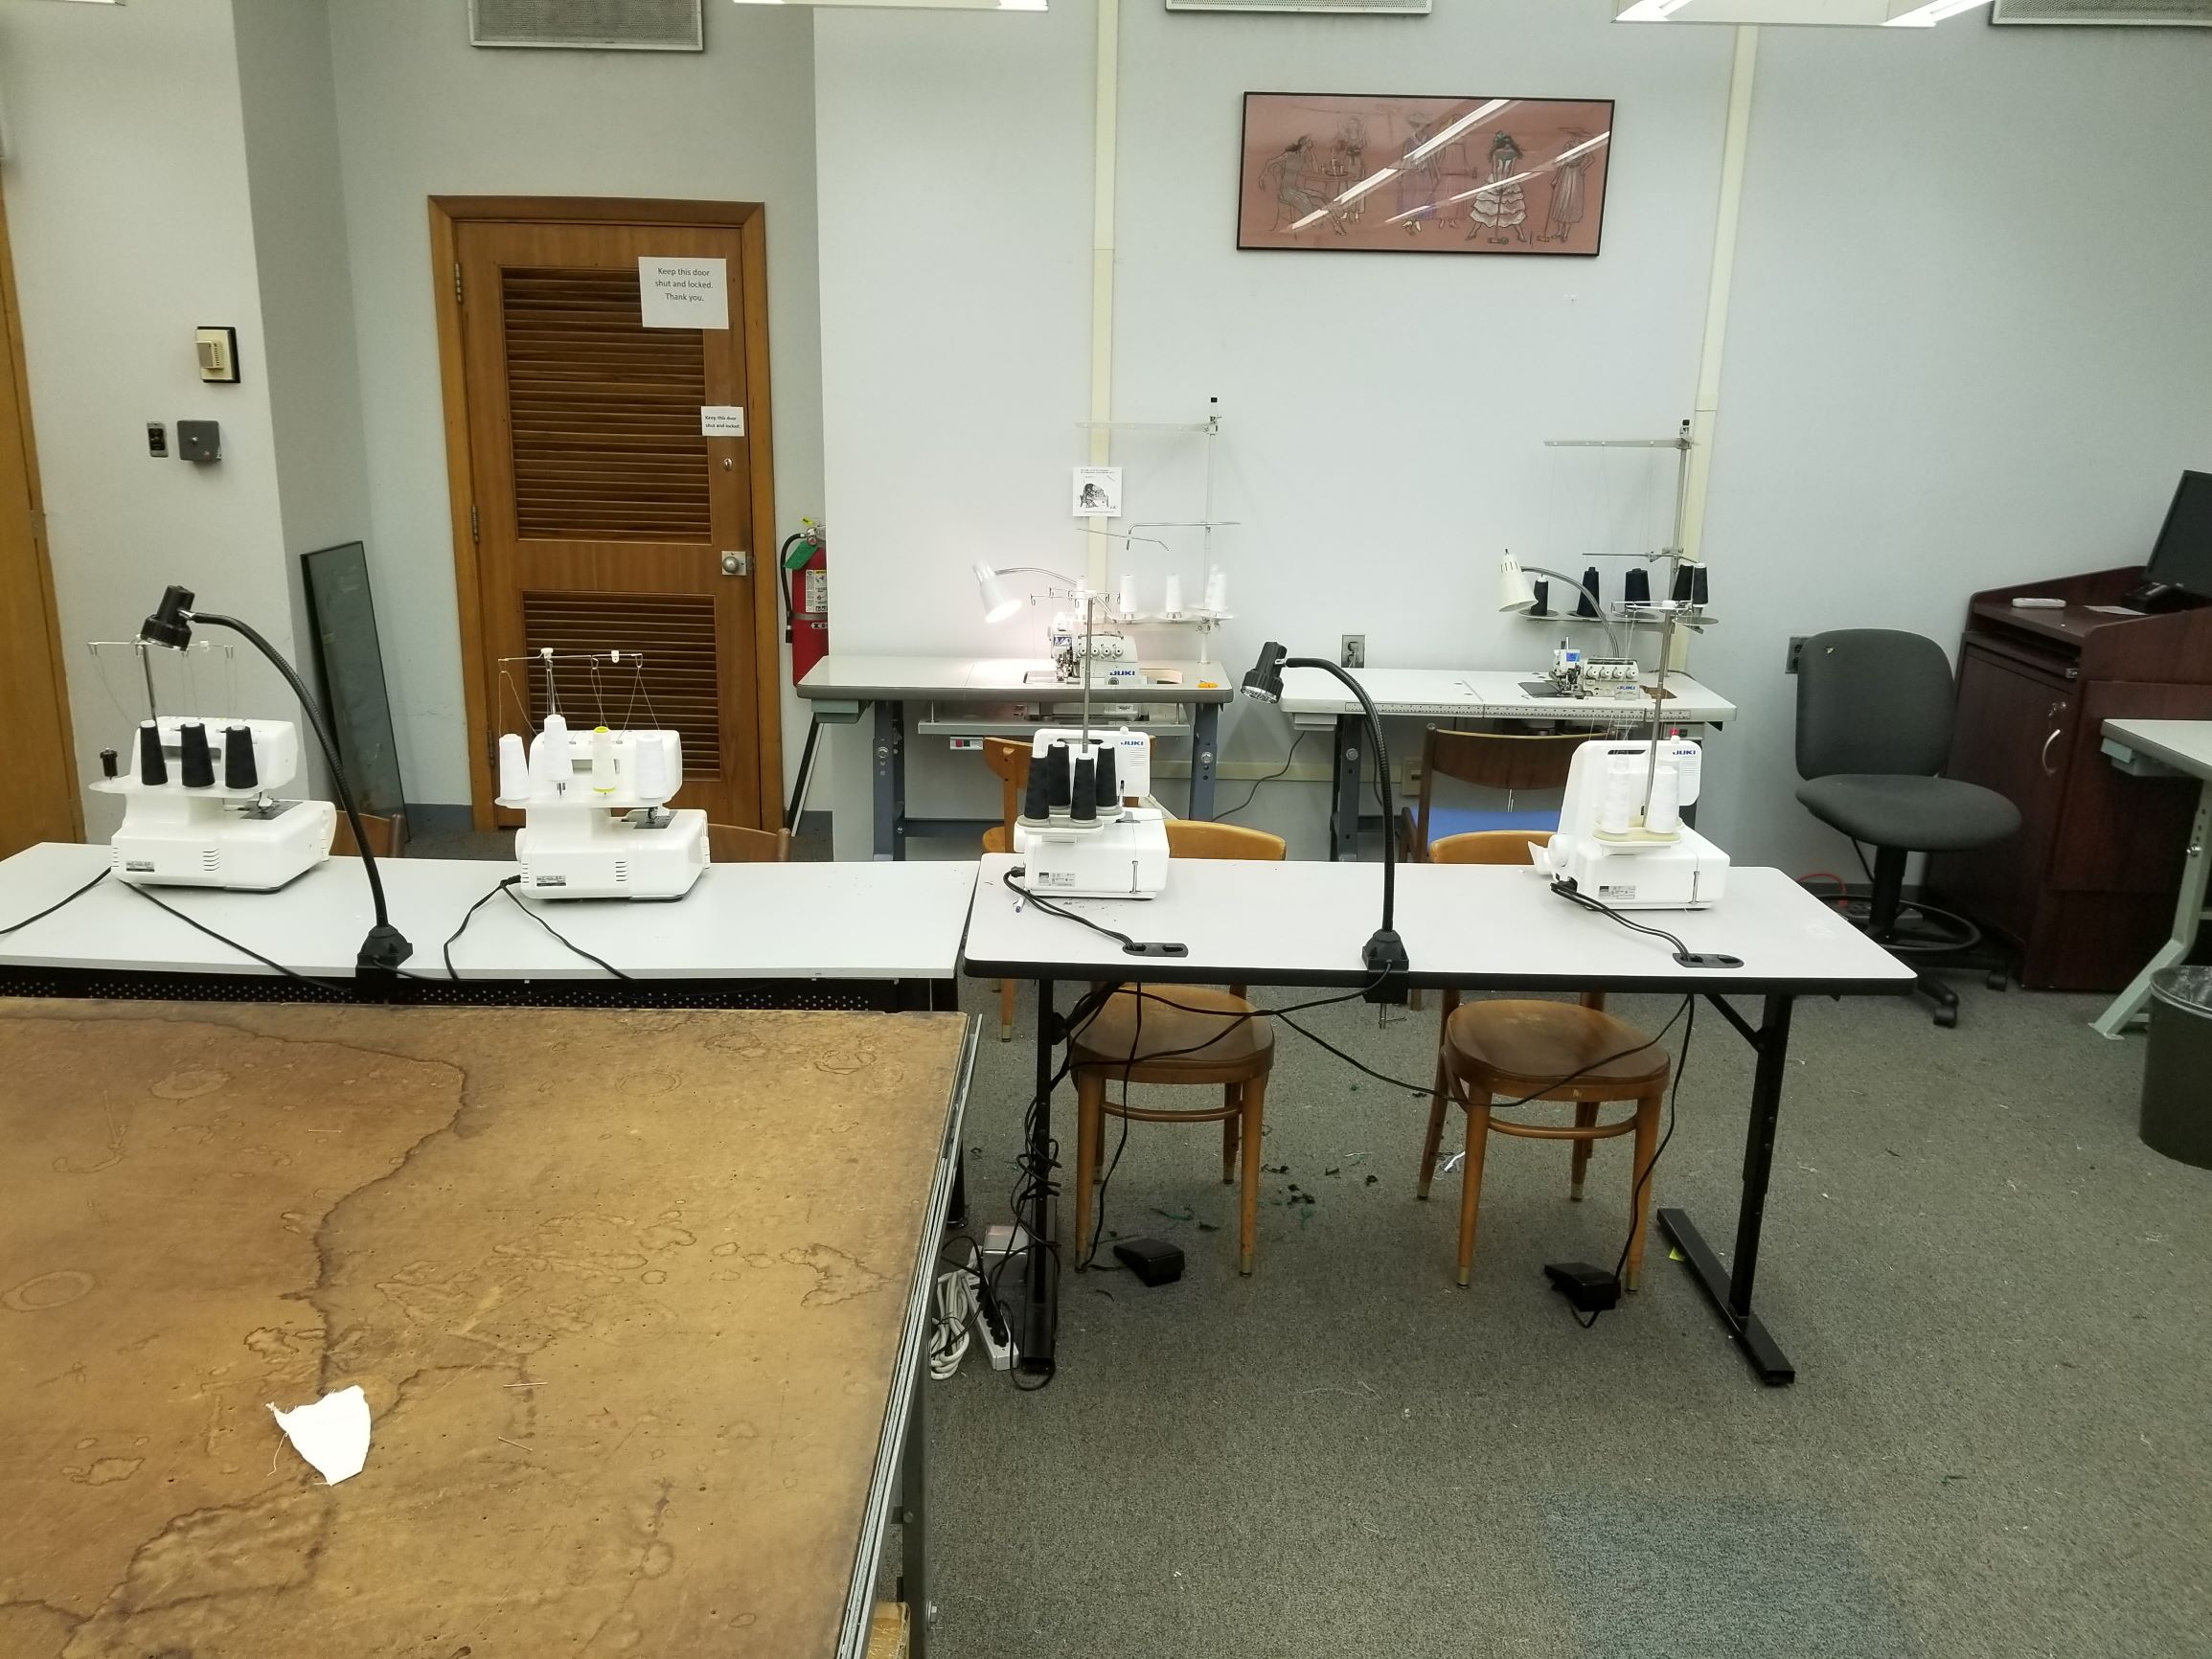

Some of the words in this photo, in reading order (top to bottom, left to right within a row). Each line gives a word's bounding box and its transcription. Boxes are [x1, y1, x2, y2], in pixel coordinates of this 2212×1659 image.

[657, 267, 676, 277] Keep
[673, 280, 687, 288] and
[688, 281, 714, 289] locked.
[665, 292, 687, 301] Thank
[688, 294, 704, 303] you.
